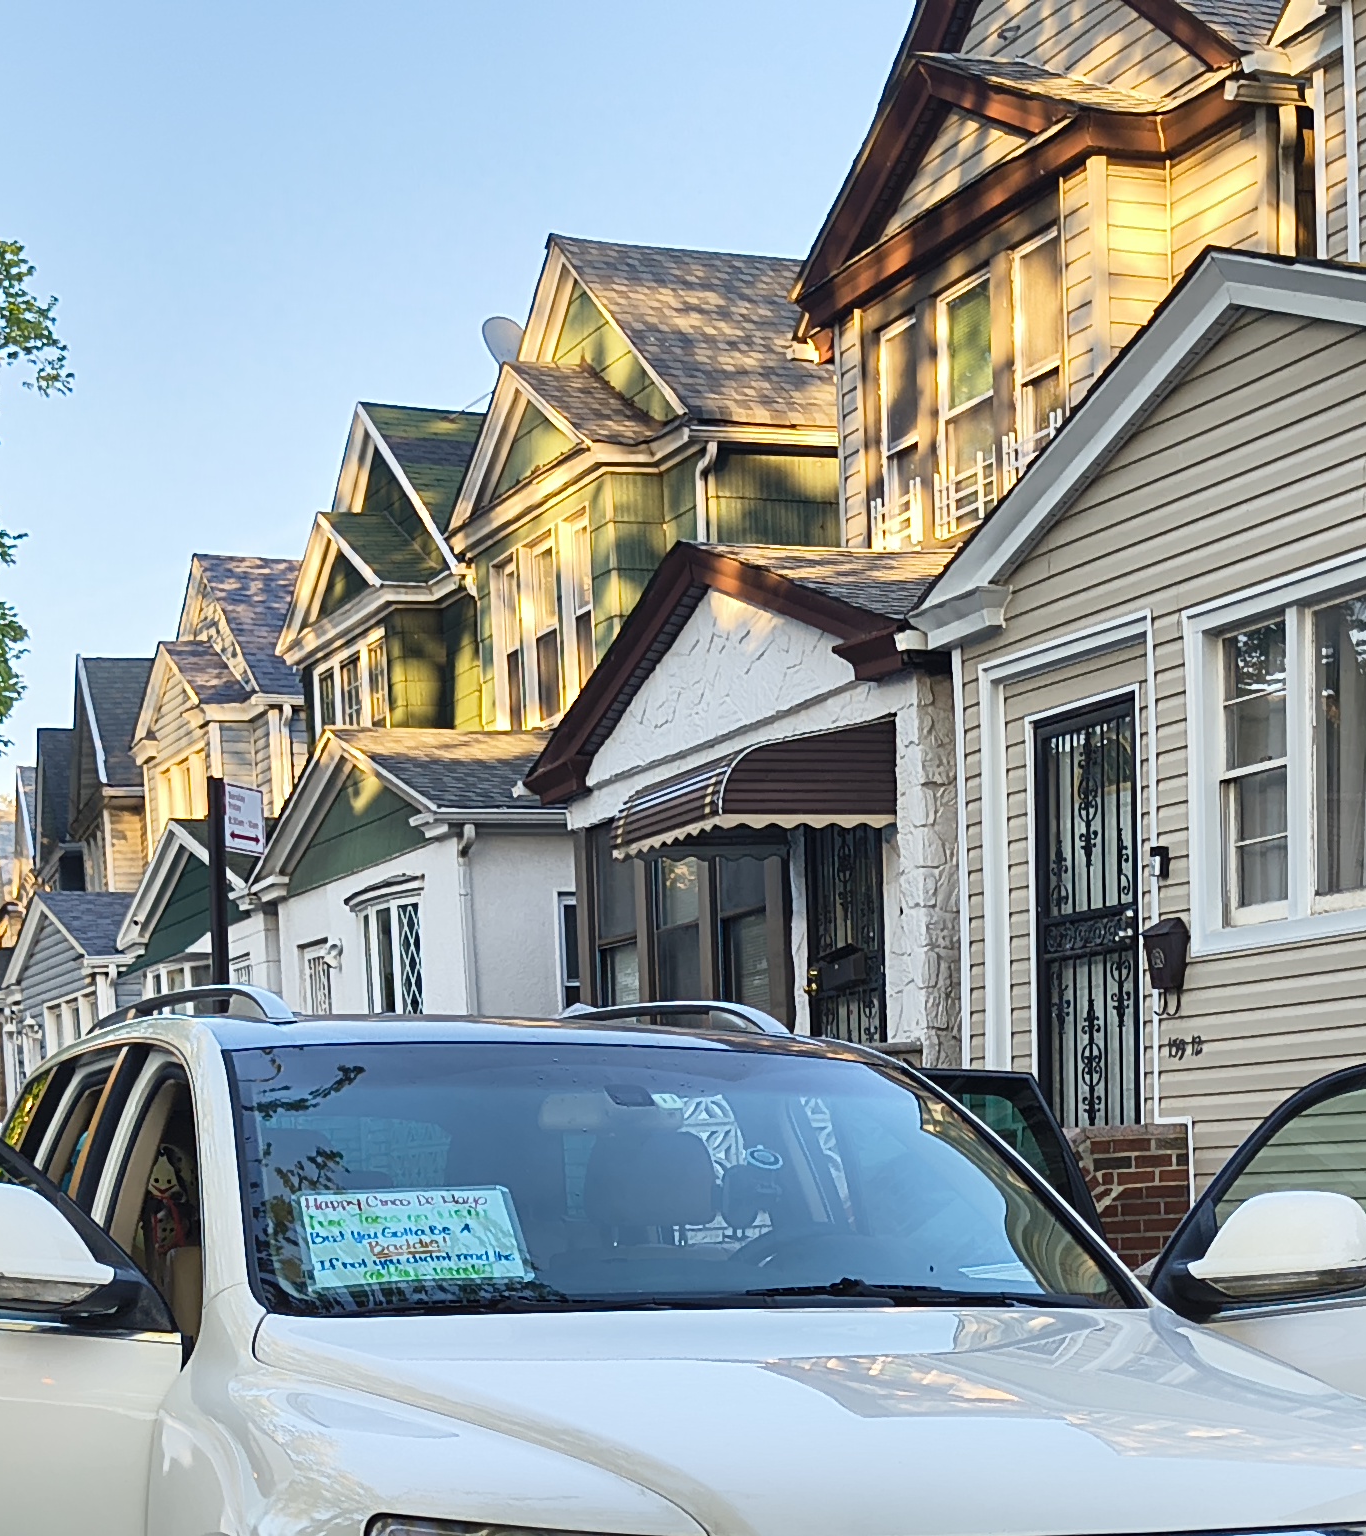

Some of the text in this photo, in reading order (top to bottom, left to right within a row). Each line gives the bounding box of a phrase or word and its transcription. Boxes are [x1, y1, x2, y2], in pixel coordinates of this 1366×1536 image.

[305, 1193, 487, 1212] Happy Cinco De Mayo
[310, 1230, 345, 1245] But
[381, 1226, 426, 1238] Gotta
[428, 1224, 451, 1236] Be
[459, 1223, 472, 1234] A
[316, 1257, 339, 1272] If
[342, 1258, 367, 1270] not
[373, 1257, 401, 1271] you
